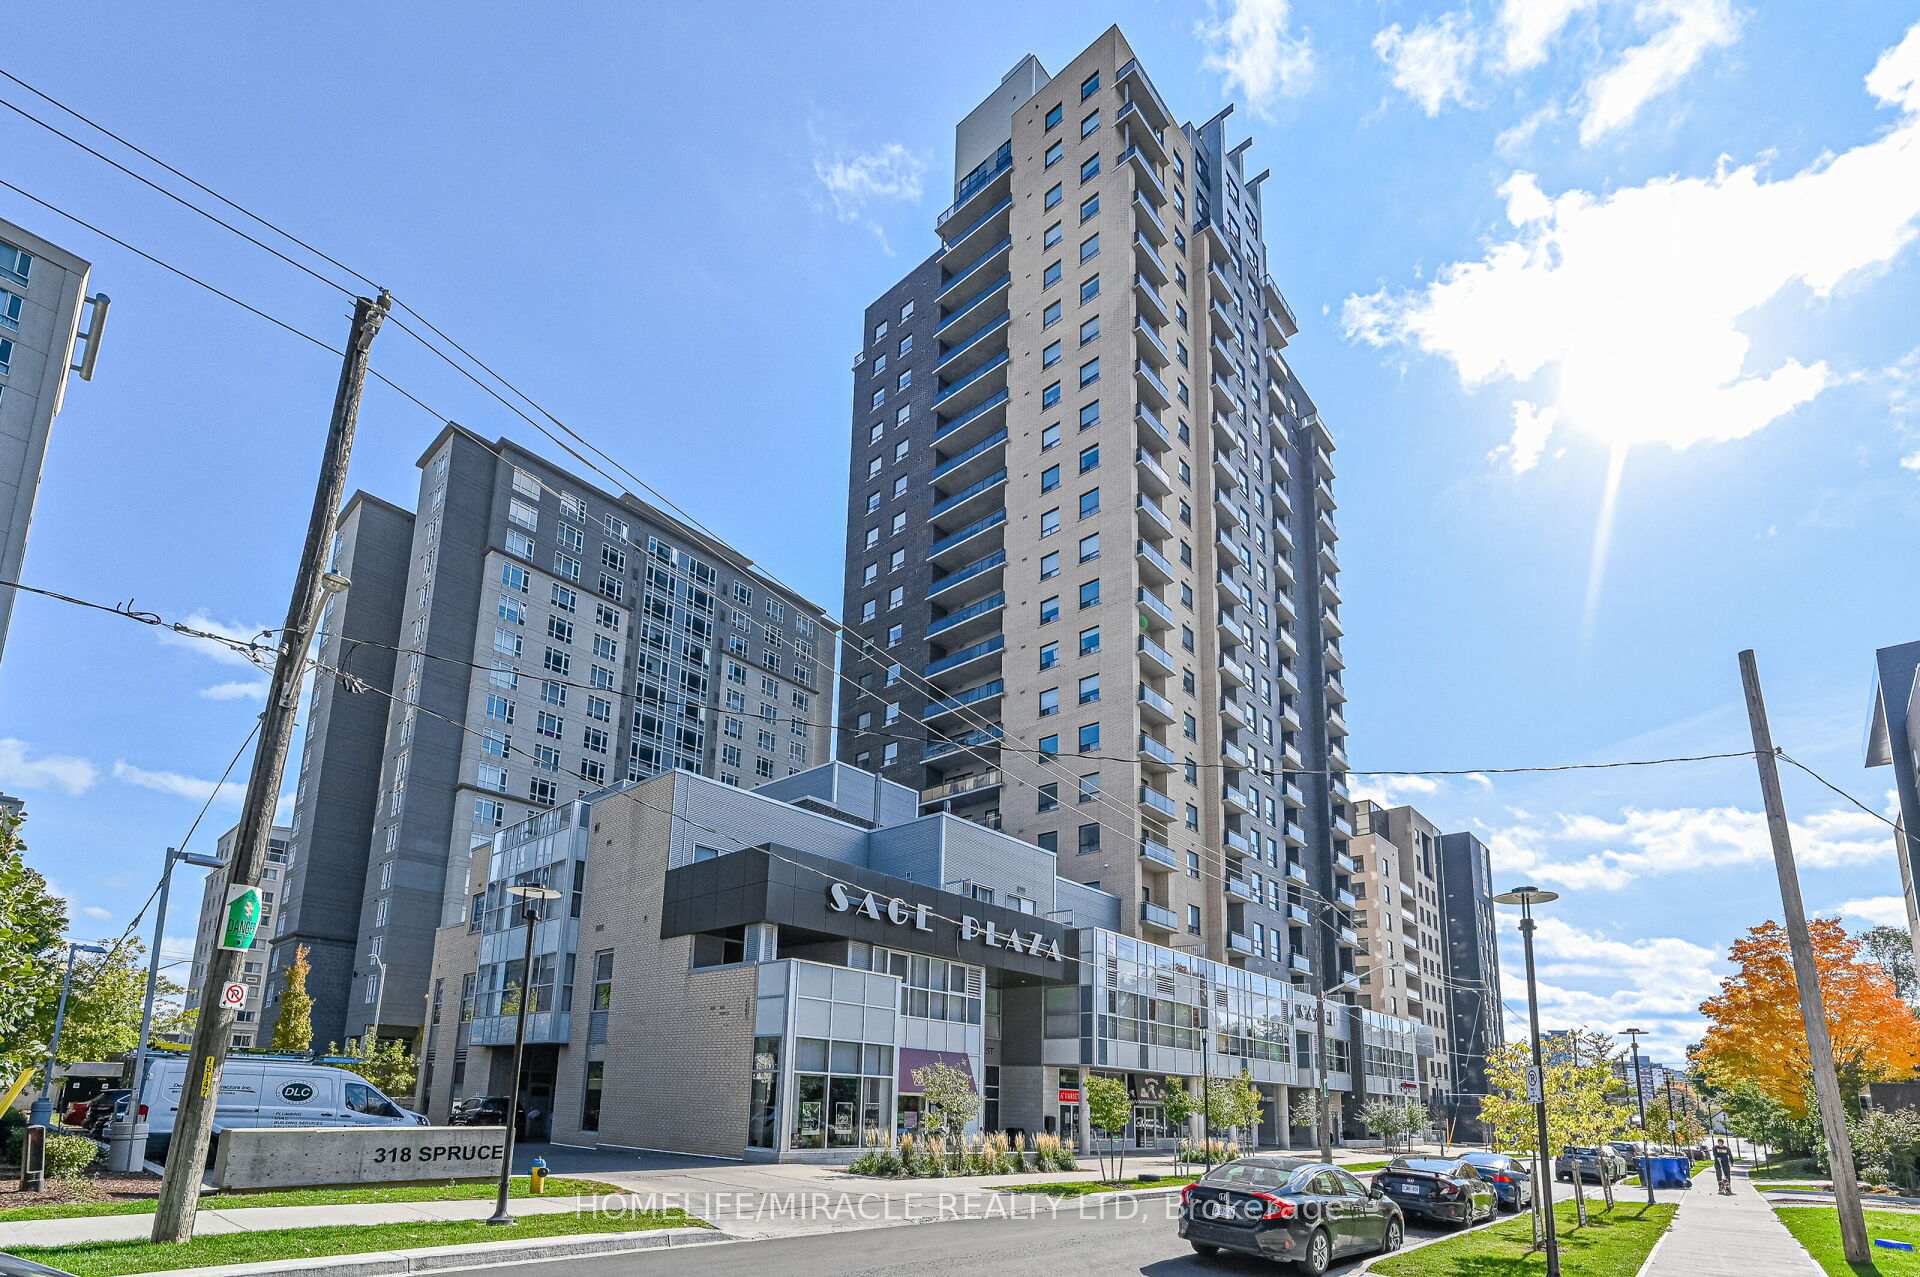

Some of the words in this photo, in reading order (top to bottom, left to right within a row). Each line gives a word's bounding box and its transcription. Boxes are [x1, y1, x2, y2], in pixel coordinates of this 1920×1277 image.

[830, 882, 934, 933] SAGE
[961, 914, 1063, 962] PLAZA
[284, 1087, 312, 1097] DLC
[373, 1147, 412, 1163] 318
[418, 1145, 504, 1161] SPRUCE
